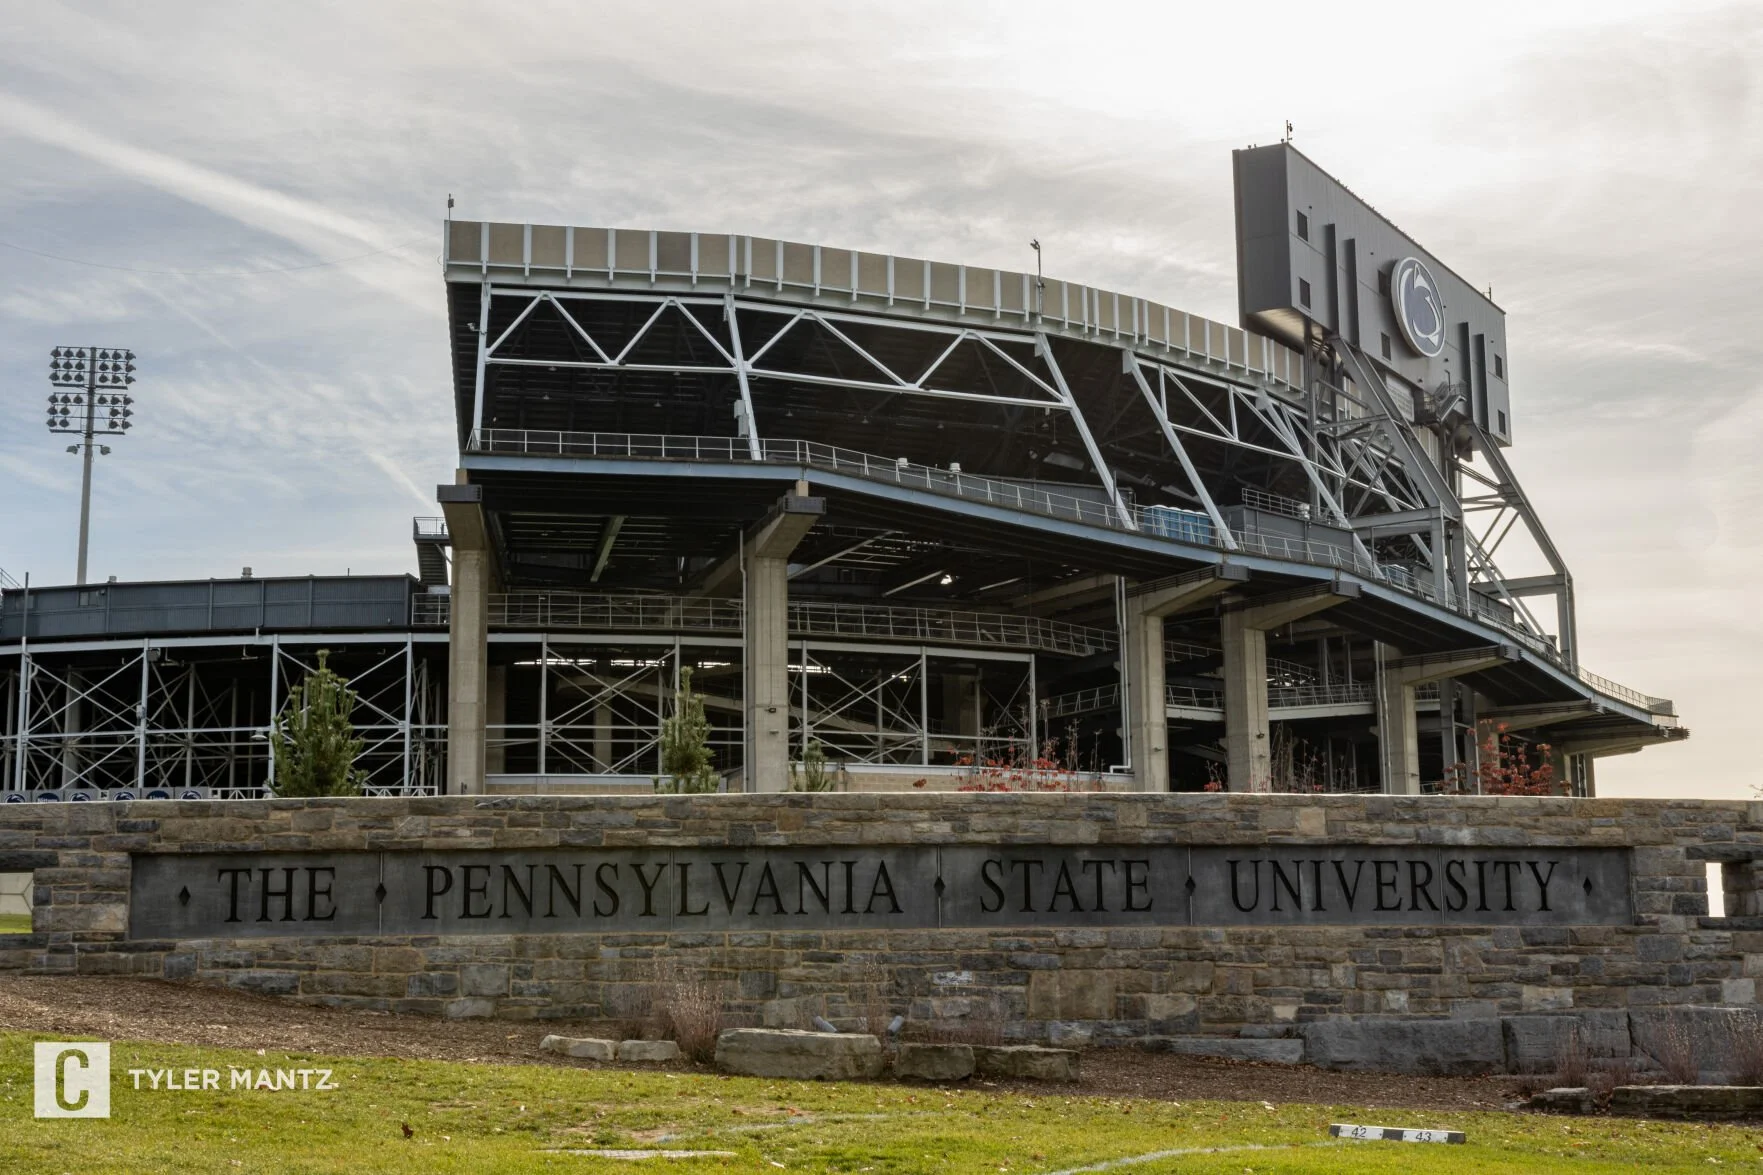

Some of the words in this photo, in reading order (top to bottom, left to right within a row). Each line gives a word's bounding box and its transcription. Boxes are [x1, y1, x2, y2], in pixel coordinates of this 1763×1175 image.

[217, 866, 338, 923] THE
[420, 859, 904, 919] PENNSYLVANIA
[980, 859, 1154, 914] STATE
[1226, 859, 1558, 913] UNIVERSITY
[1351, 1127, 1367, 1138] 42
[1415, 1131, 1432, 1142] 43
